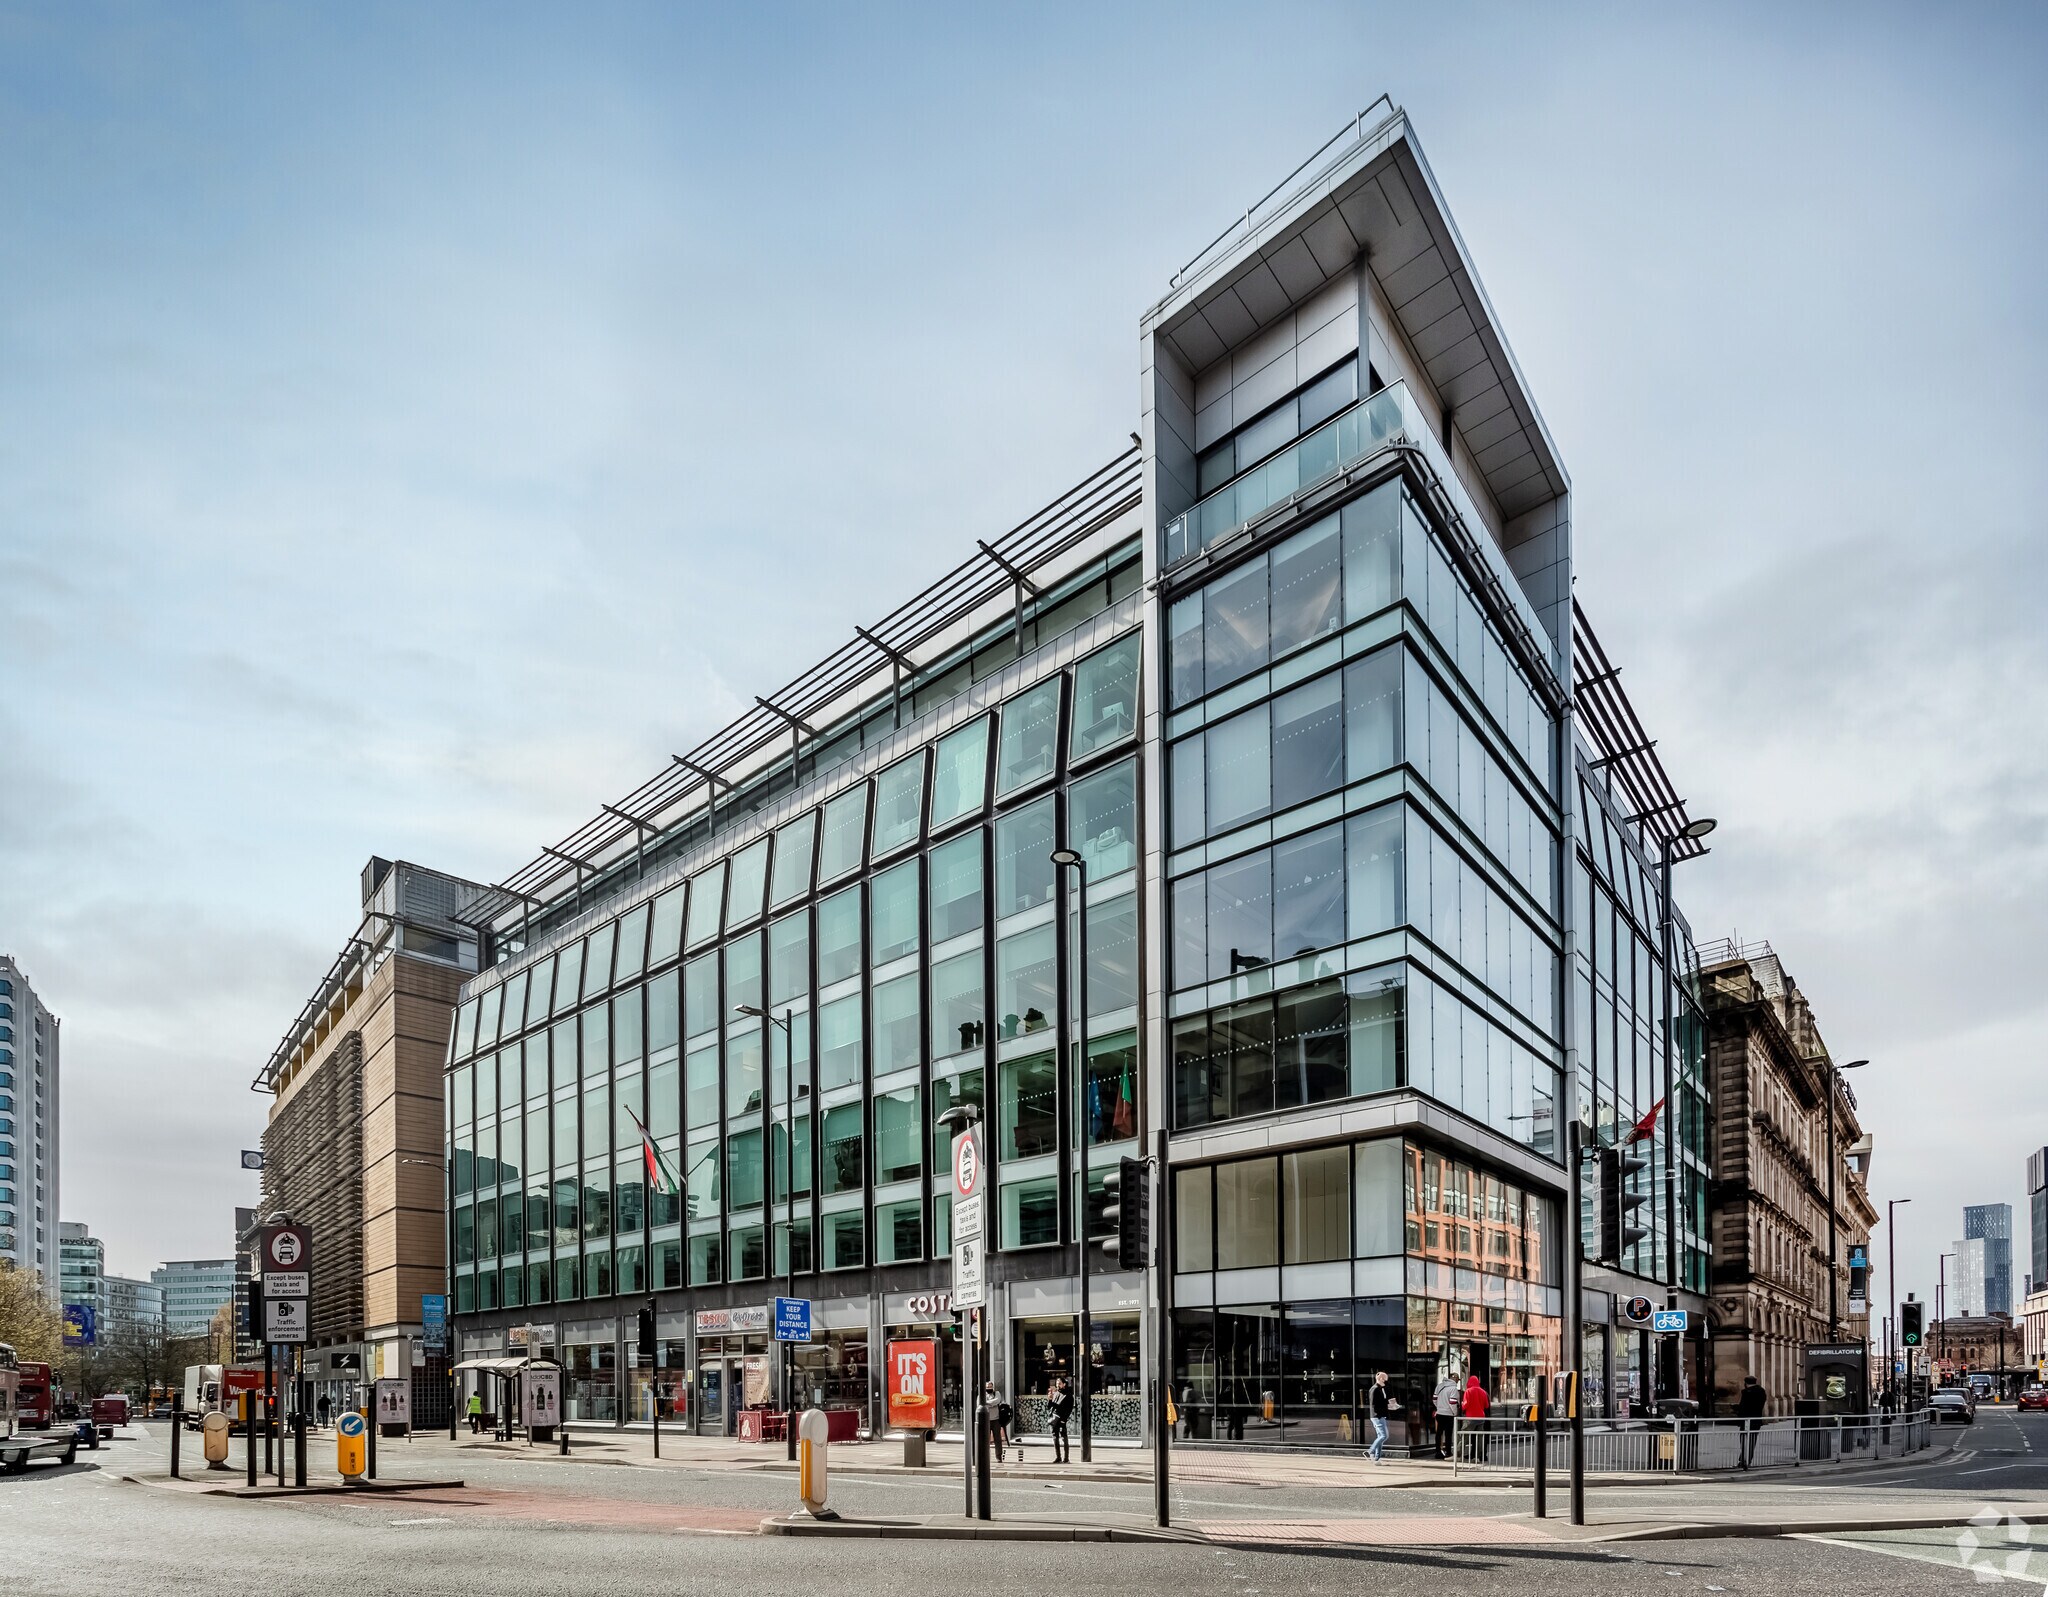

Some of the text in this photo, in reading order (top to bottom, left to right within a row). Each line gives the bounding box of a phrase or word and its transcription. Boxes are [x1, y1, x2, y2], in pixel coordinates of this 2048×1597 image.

[956, 1205, 968, 1216] Except
[965, 1223, 978, 1233] access
[962, 1269, 975, 1279] Traffic
[957, 1279, 980, 1291] enforcement
[961, 1291, 977, 1300] cameras
[782, 1298, 804, 1306] Coronavirus
[786, 1305, 801, 1313] KEEP
[697, 1312, 729, 1325] TESCO
[779, 1320, 808, 1328] DISTANCE
[1302, 1349, 1307, 1359] 1
[746, 1362, 763, 1370] FRESH
[897, 1353, 927, 1375] IT'S
[1303, 1370, 1307, 1380] 2
[1330, 1370, 1334, 1380] 5
[900, 1374, 924, 1395] ON
[1303, 1391, 1307, 1402] 3
[1330, 1391, 1335, 1401] 6
